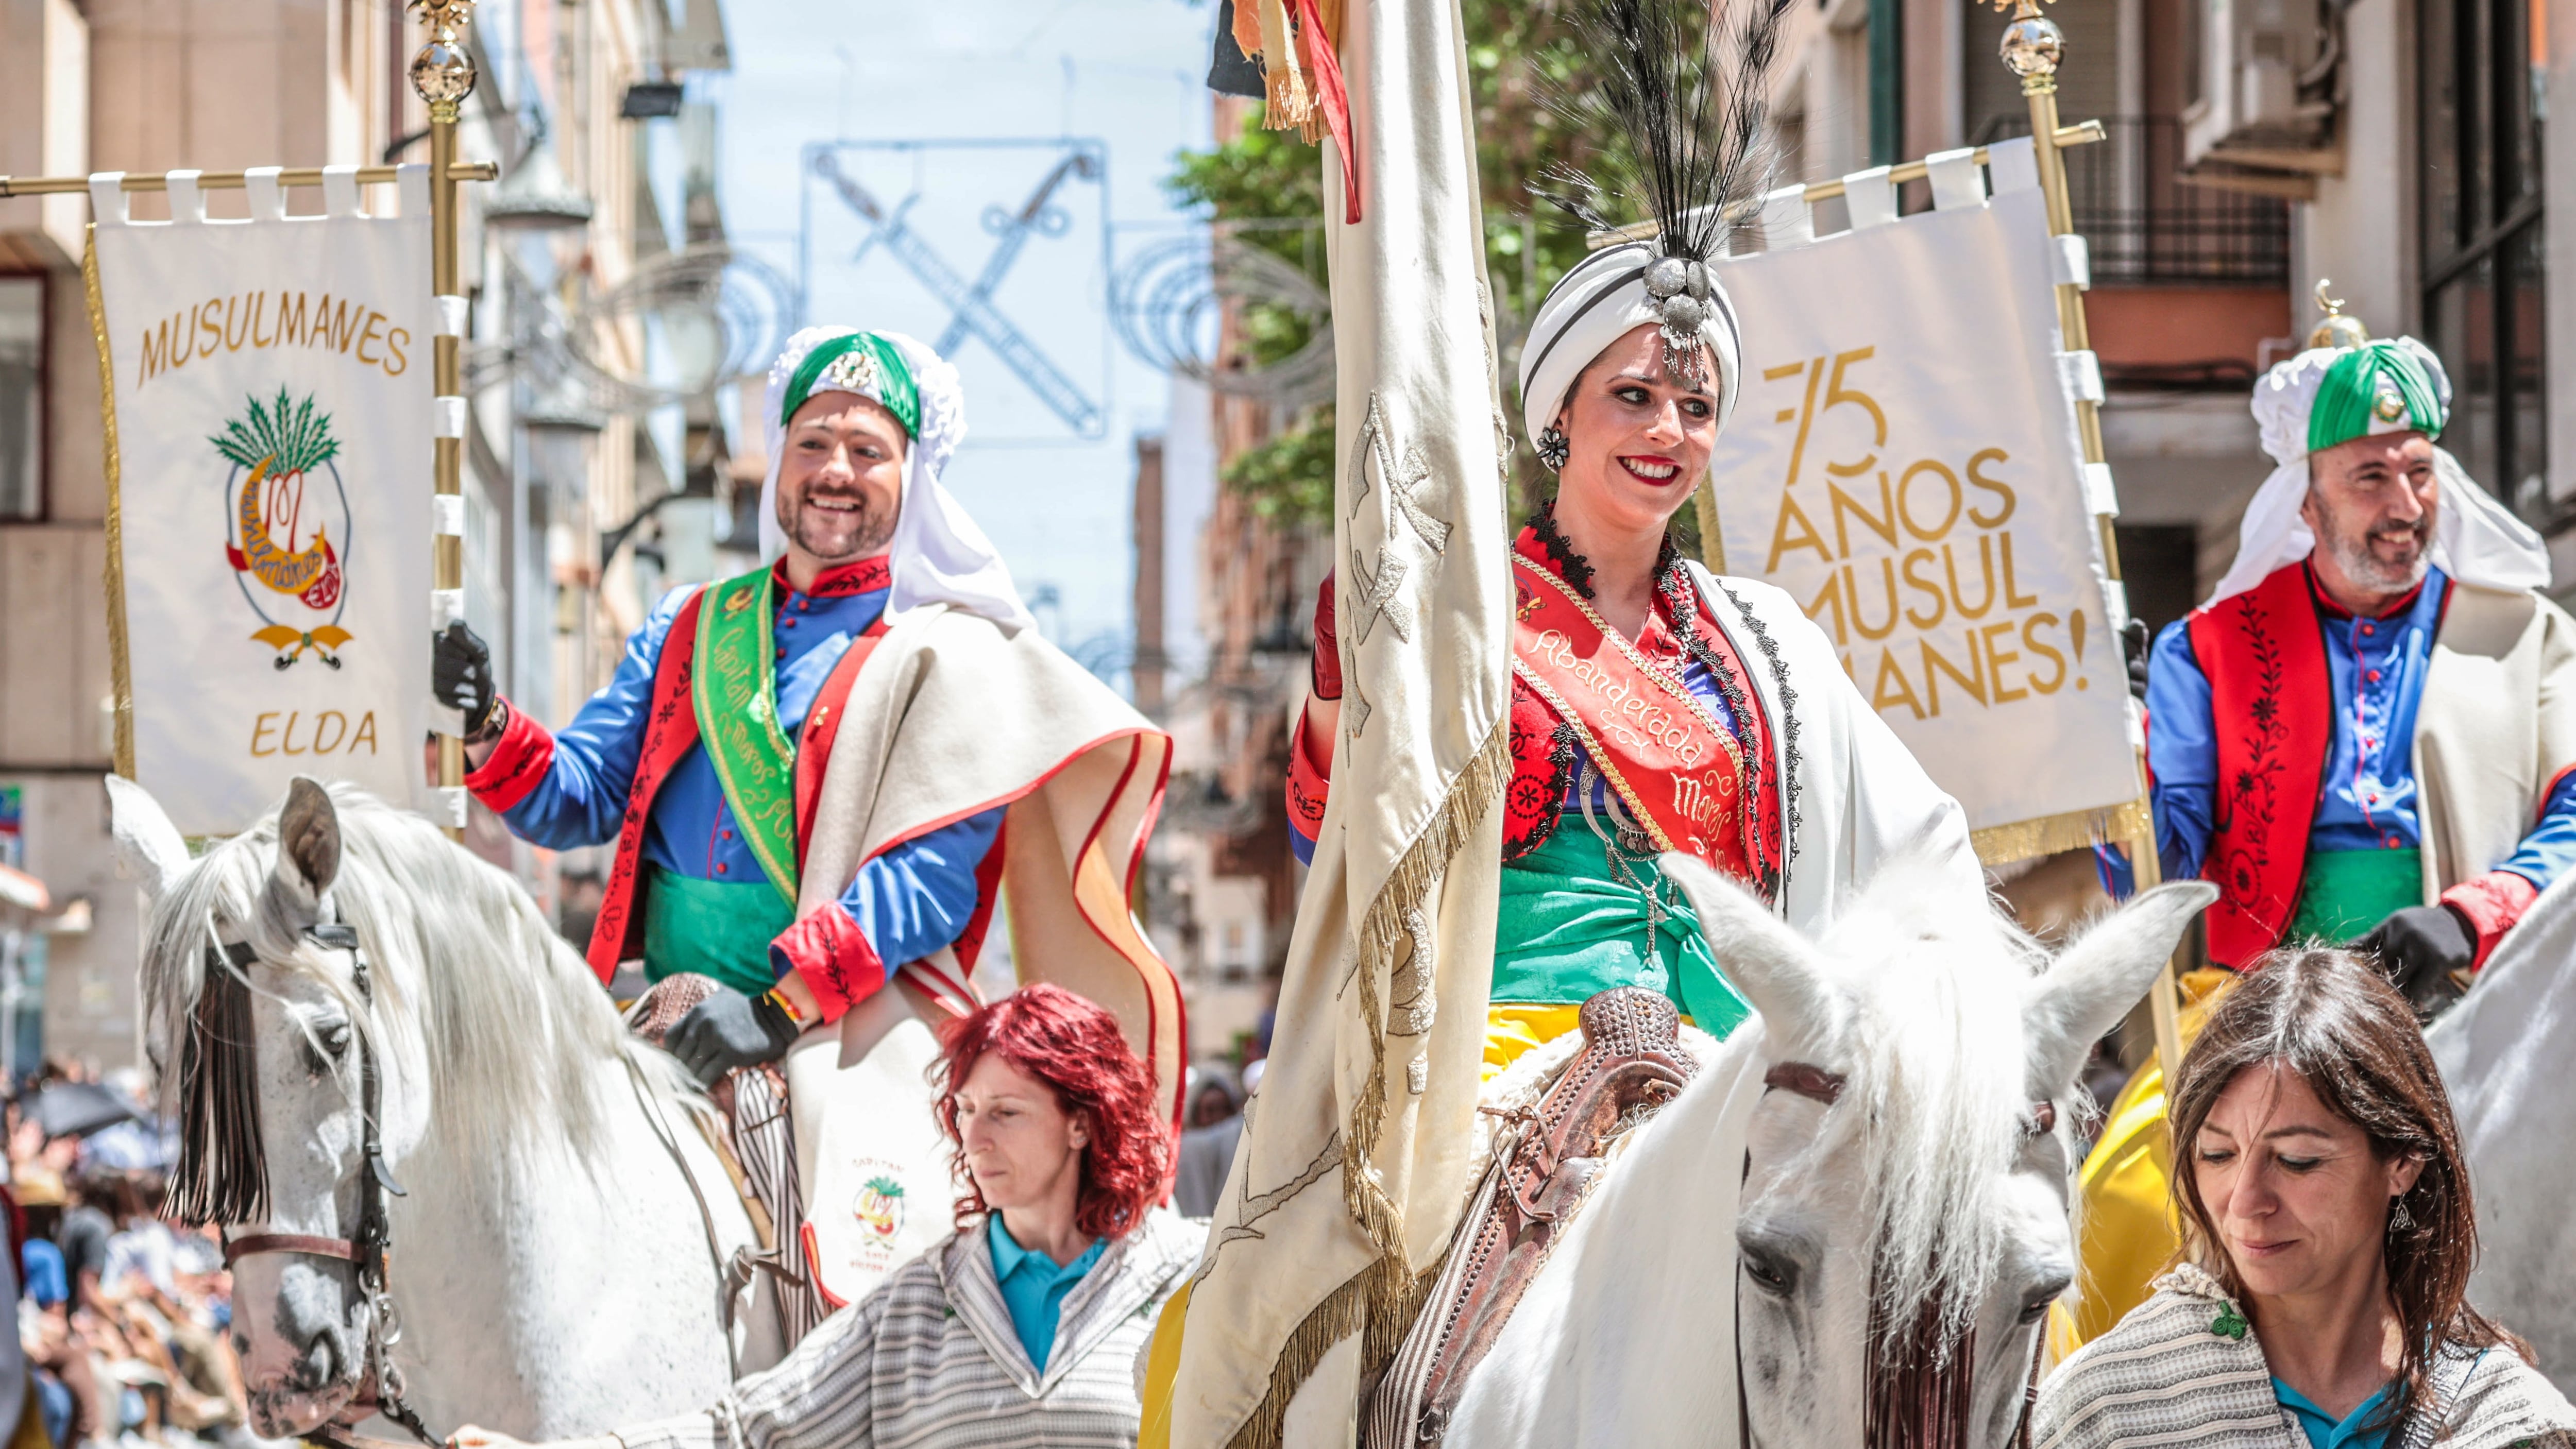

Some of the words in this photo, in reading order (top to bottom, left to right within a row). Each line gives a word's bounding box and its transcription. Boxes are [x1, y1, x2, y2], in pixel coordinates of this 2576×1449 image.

[138, 290, 410, 390] MUSULMANES
[1763, 345, 1888, 486] 75
[1528, 629, 1703, 770] Abanderada
[1841, 608, 2089, 721] ANES!
[250, 709, 377, 758] ELDA
